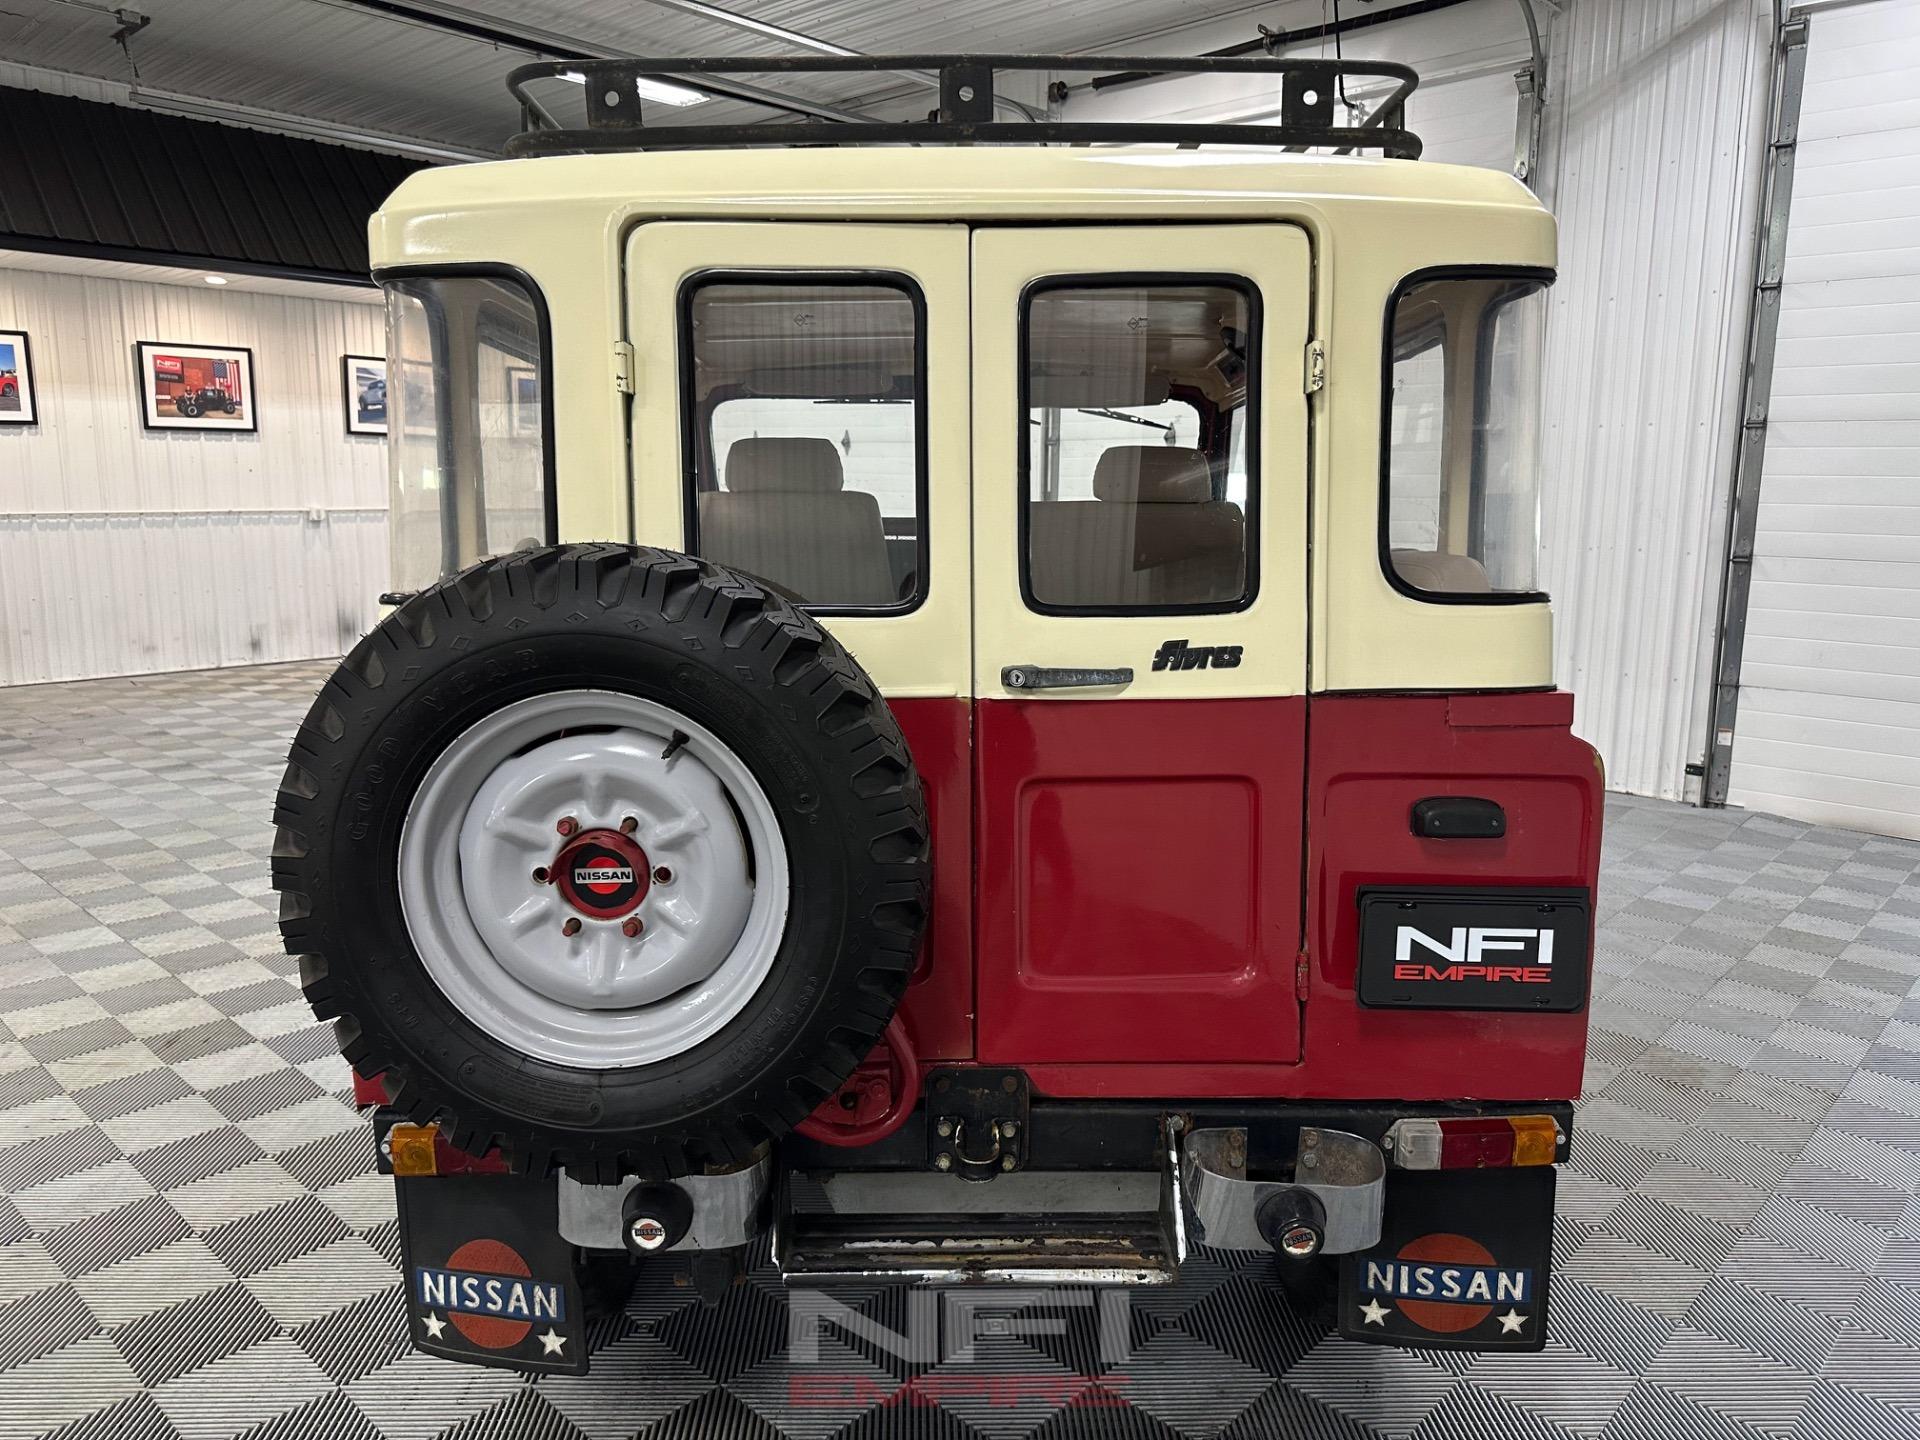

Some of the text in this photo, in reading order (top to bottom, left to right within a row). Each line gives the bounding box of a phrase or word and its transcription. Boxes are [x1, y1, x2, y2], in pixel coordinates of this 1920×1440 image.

[576, 871, 631, 880] NISSAN
[1396, 926, 1554, 963] NFI
[1394, 965, 1552, 982] EMPIRE
[423, 1272, 557, 1318] NISSAN
[1367, 1261, 1524, 1300] NISSAN
